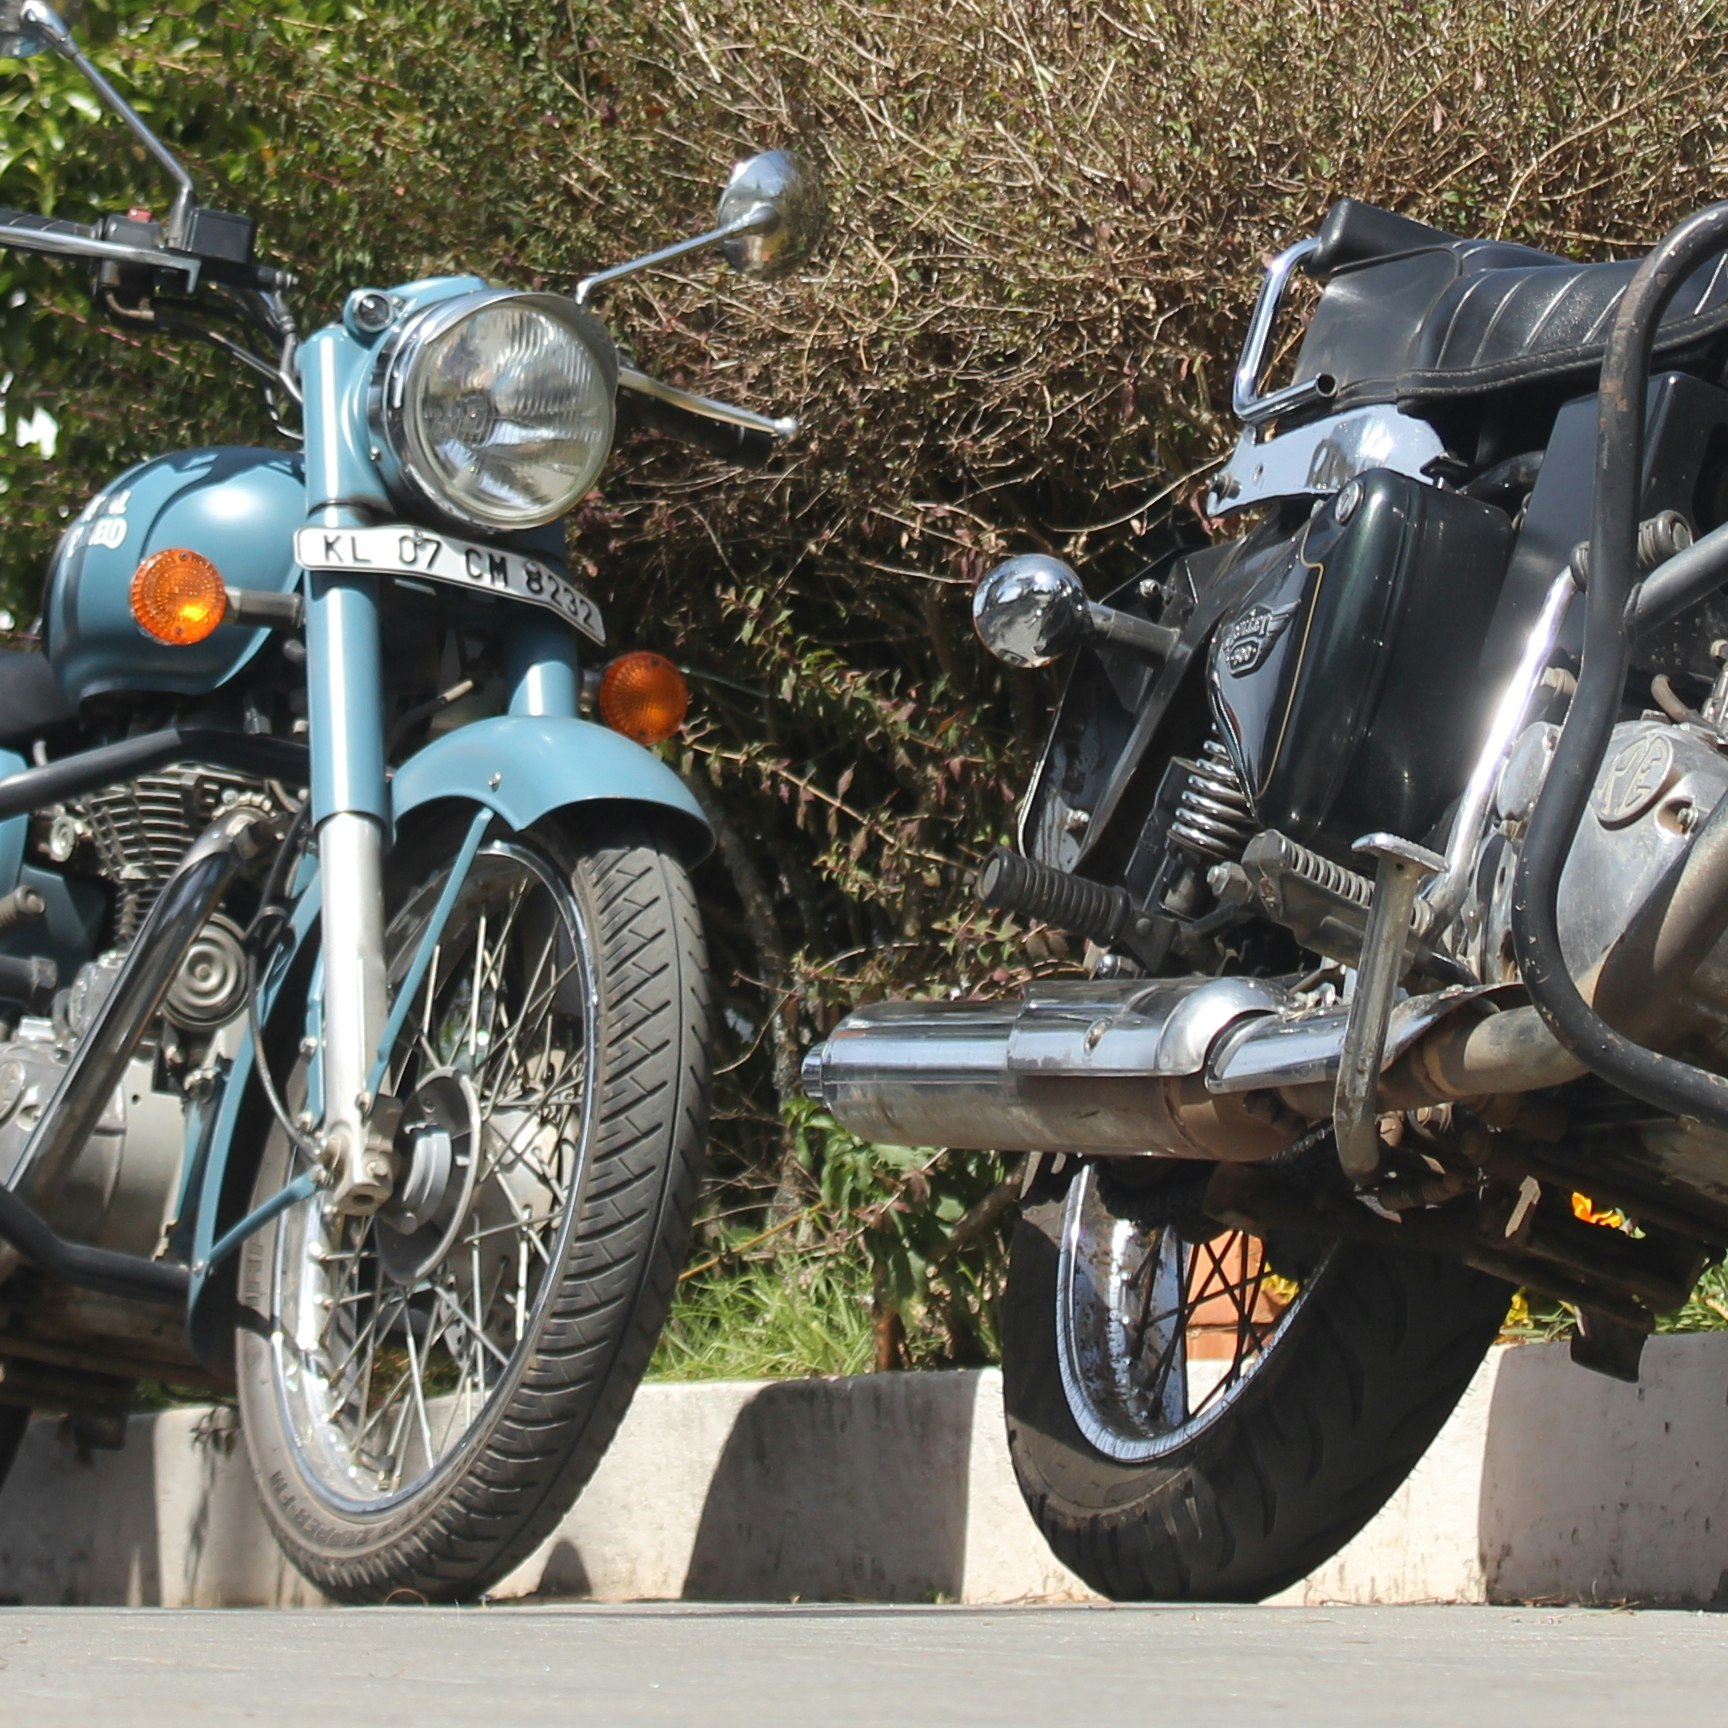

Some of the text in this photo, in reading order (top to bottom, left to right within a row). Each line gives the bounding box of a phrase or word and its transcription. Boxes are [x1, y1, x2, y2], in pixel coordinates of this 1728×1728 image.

[323, 534, 597, 630] KL 07 CM 8232
